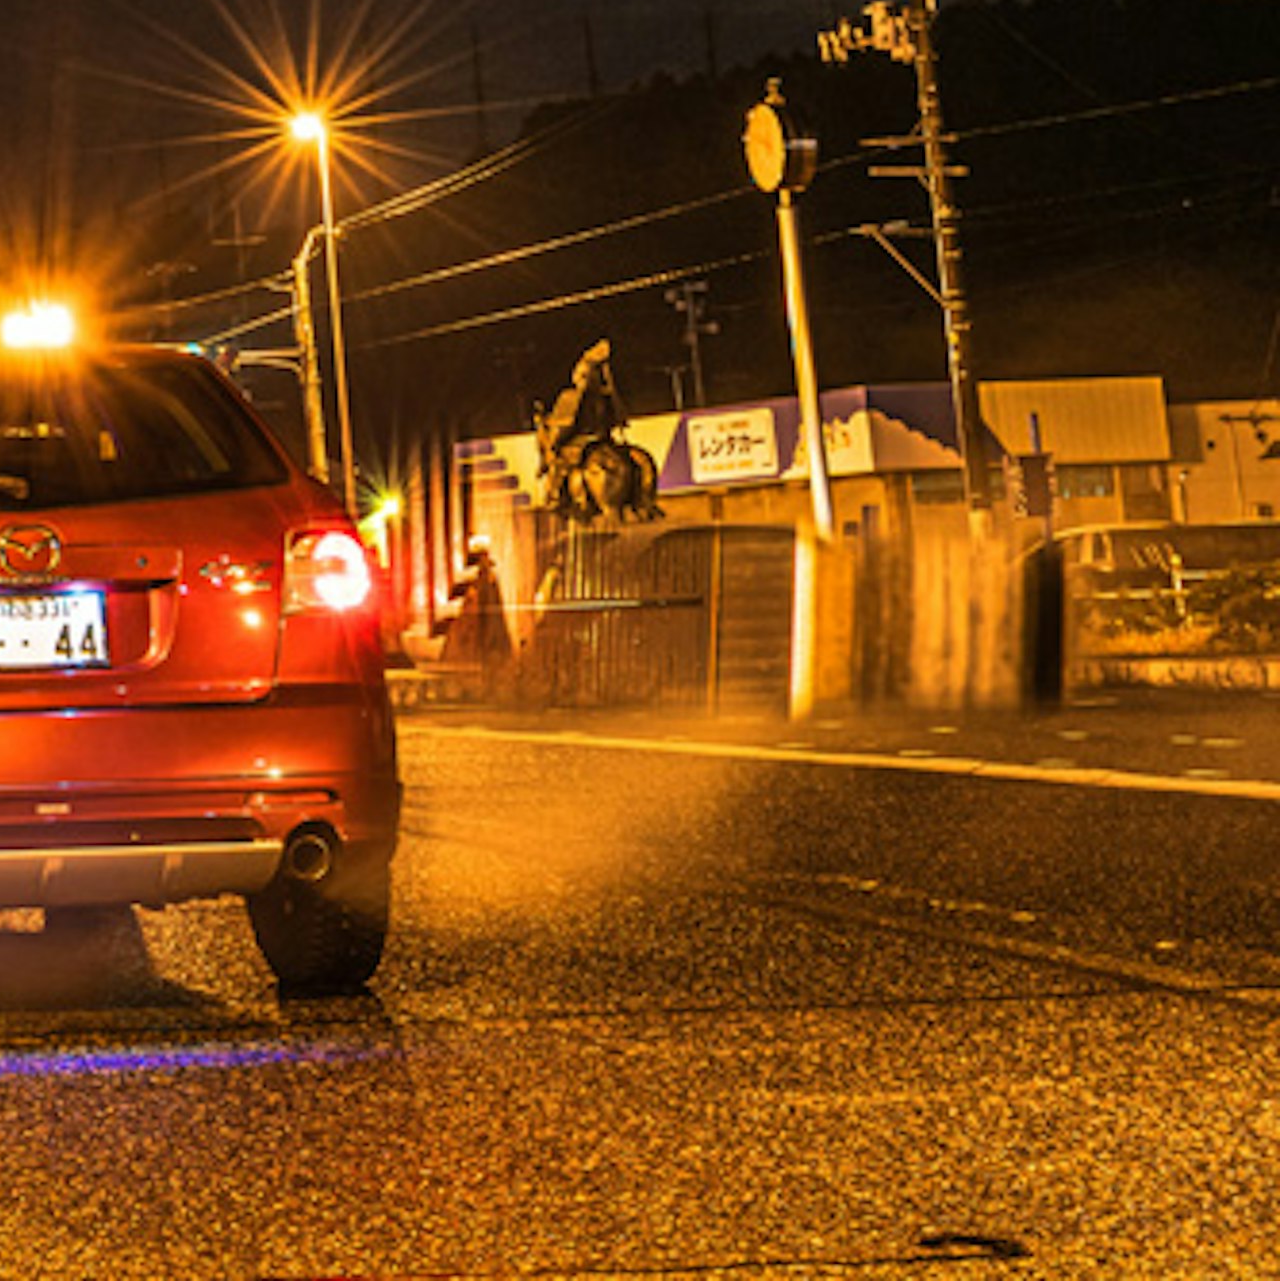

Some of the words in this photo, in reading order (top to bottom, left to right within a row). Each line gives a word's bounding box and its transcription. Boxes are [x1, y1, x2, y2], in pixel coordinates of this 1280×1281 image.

[699, 432, 765, 458] レンタカー
